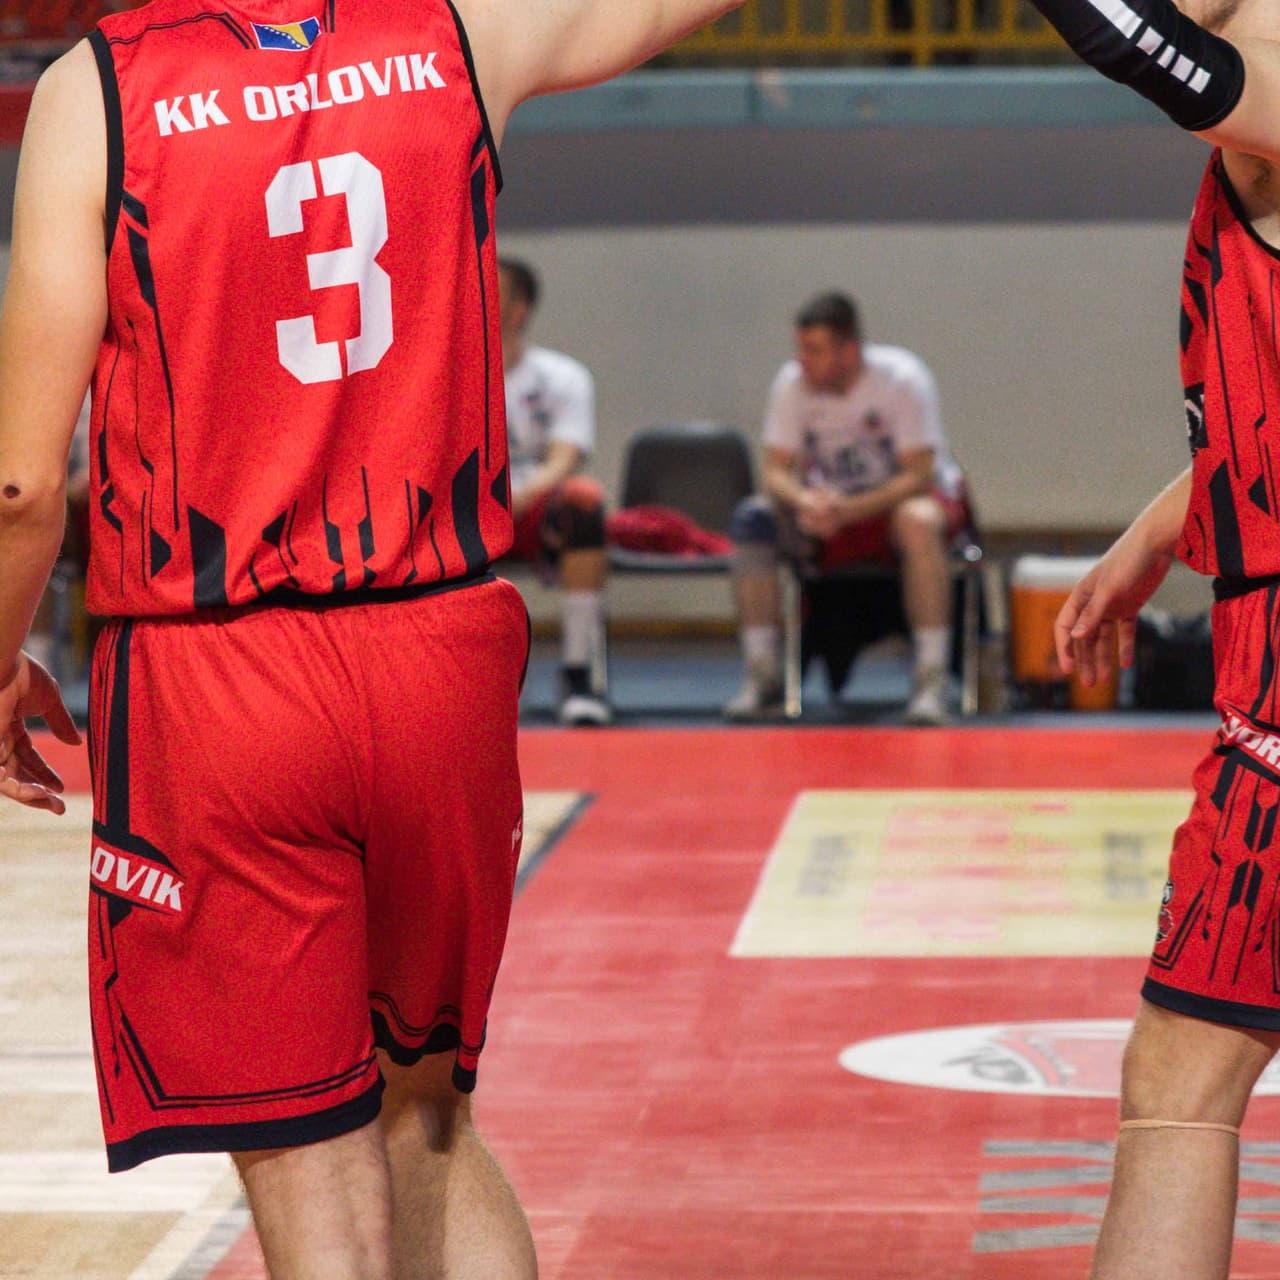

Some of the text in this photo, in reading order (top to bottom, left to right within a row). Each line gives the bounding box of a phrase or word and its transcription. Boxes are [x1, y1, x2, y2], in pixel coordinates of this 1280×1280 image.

[153, 51, 448, 137] KK ORLOVIK
[265, 151, 394, 385] 3
